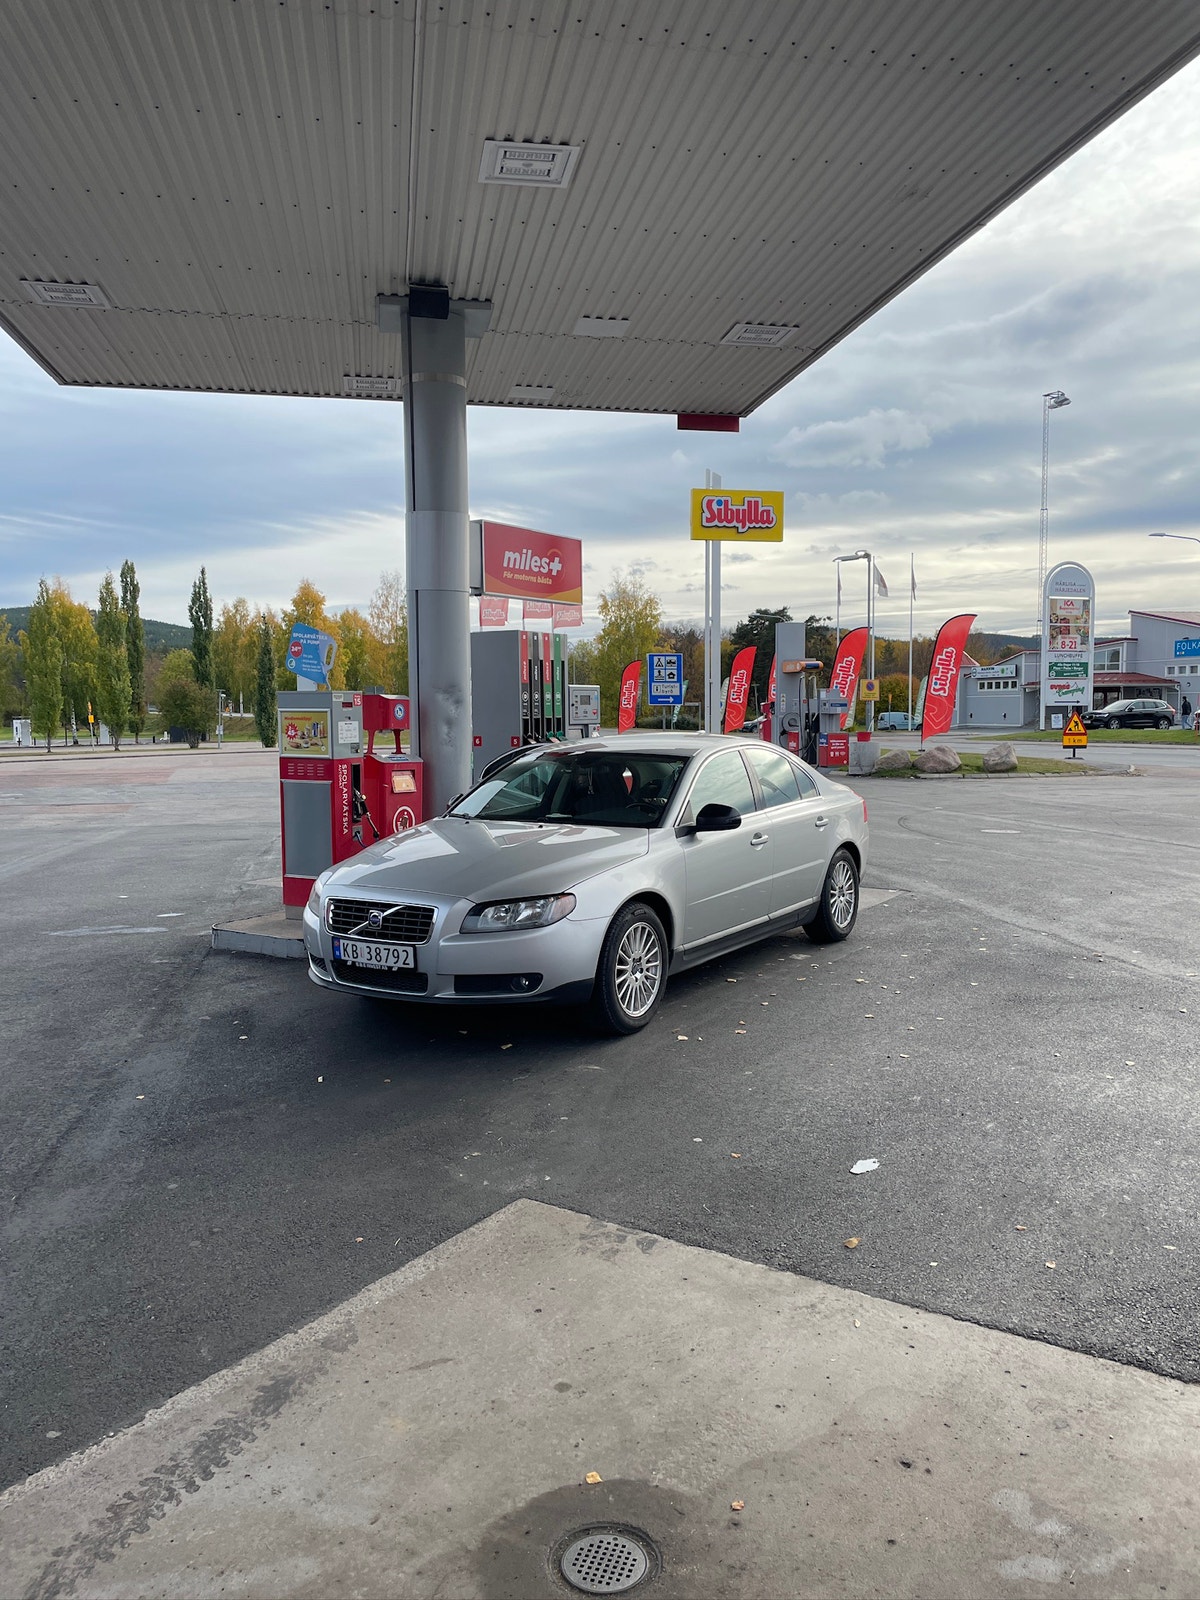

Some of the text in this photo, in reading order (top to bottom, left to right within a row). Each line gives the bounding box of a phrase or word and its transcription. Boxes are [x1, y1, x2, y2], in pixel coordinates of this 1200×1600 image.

[704, 497, 775, 531] Sibylla
[503, 571, 553, 585] För motorns bästa
[1060, 640, 1077, 649] 8-21
[730, 669, 747, 703] Sibylla
[931, 647, 956, 697] Sibylla
[622, 680, 635, 709] Sibylla
[342, 942, 359, 960] KB
[366, 945, 410, 966] 38792
